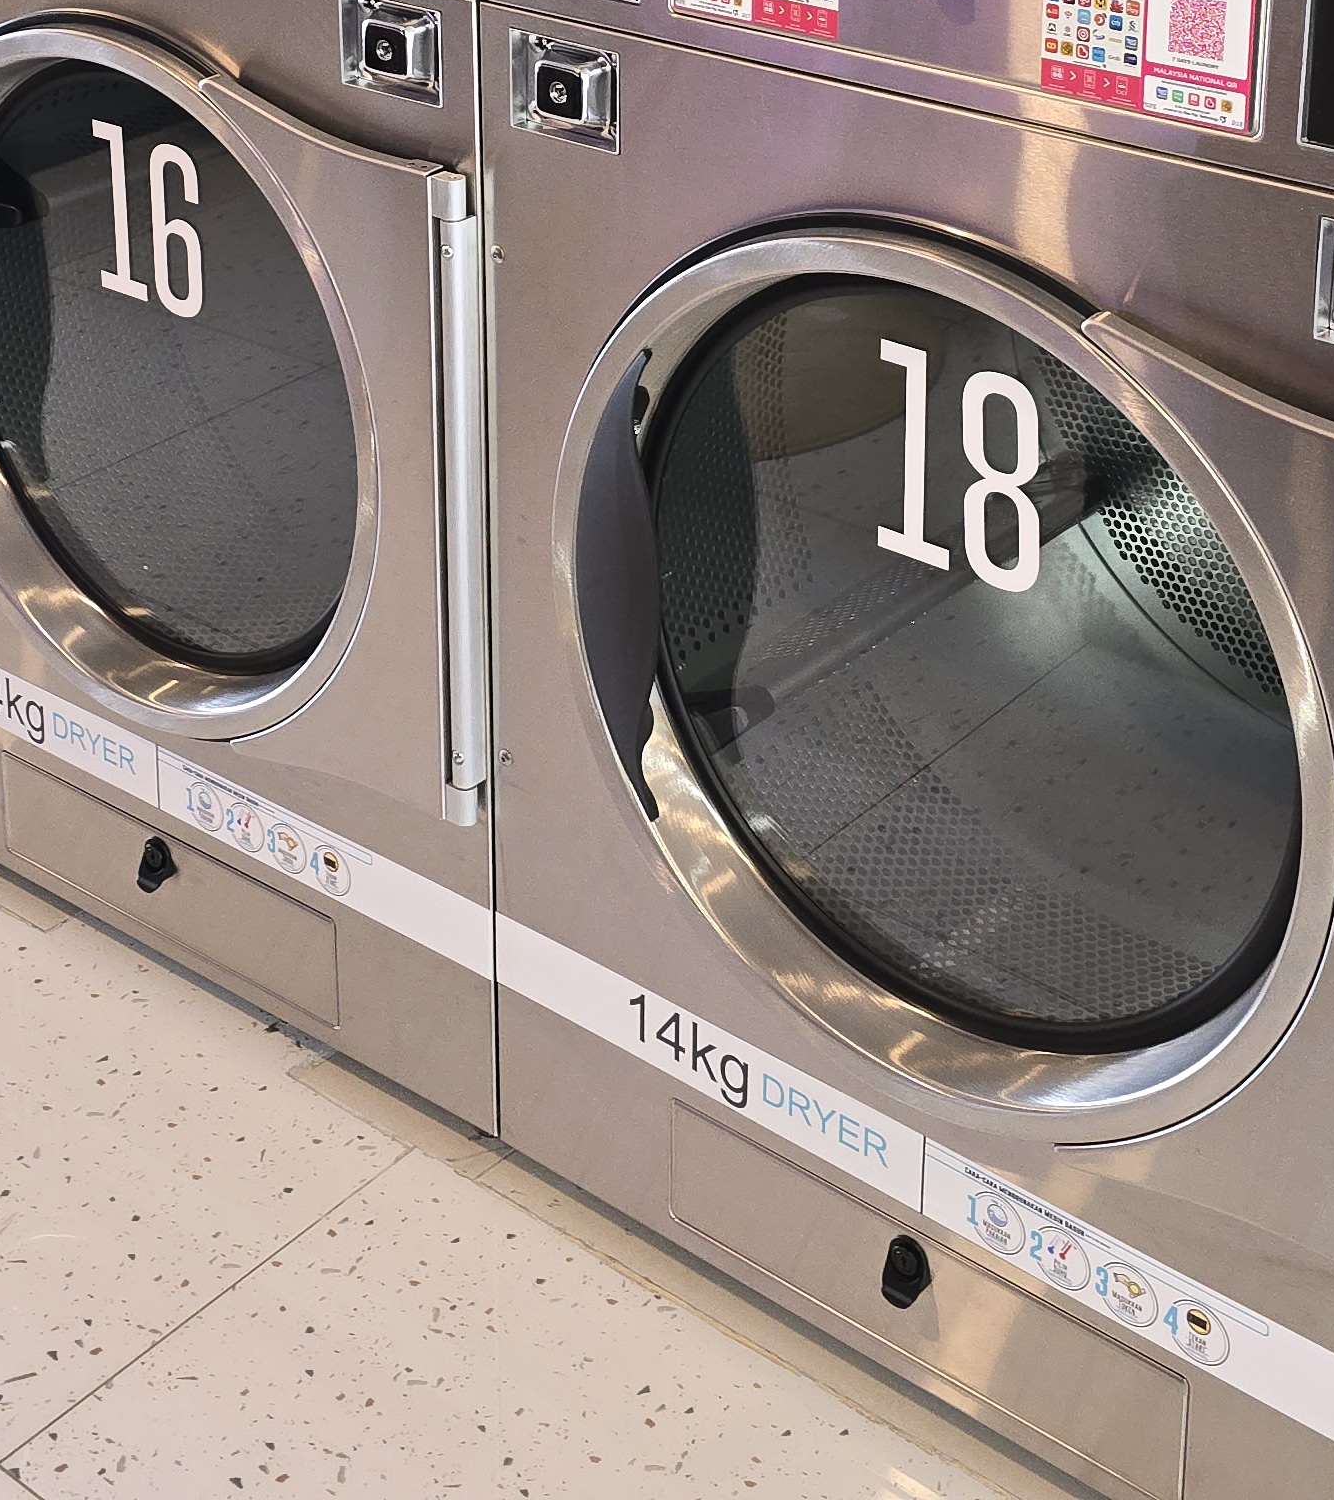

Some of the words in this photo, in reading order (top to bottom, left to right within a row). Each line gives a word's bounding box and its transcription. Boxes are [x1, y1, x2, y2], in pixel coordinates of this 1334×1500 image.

[1153, 66, 1188, 79] MALAYSIA
[1188, 74, 1226, 87] NATIONAL
[1226, 81, 1238, 89] QR
[91, 119, 203, 317] 16
[877, 338, 1040, 592] 18
[52, 712, 137, 775] DRYER
[629, 993, 750, 1109] 14kg
[761, 1073, 889, 1169] DRYER
[967, 1194, 979, 1227] 1
[1029, 1230, 1043, 1262] 2
[1095, 1266, 1109, 1297] 3
[1163, 1305, 1179, 1336] 4
